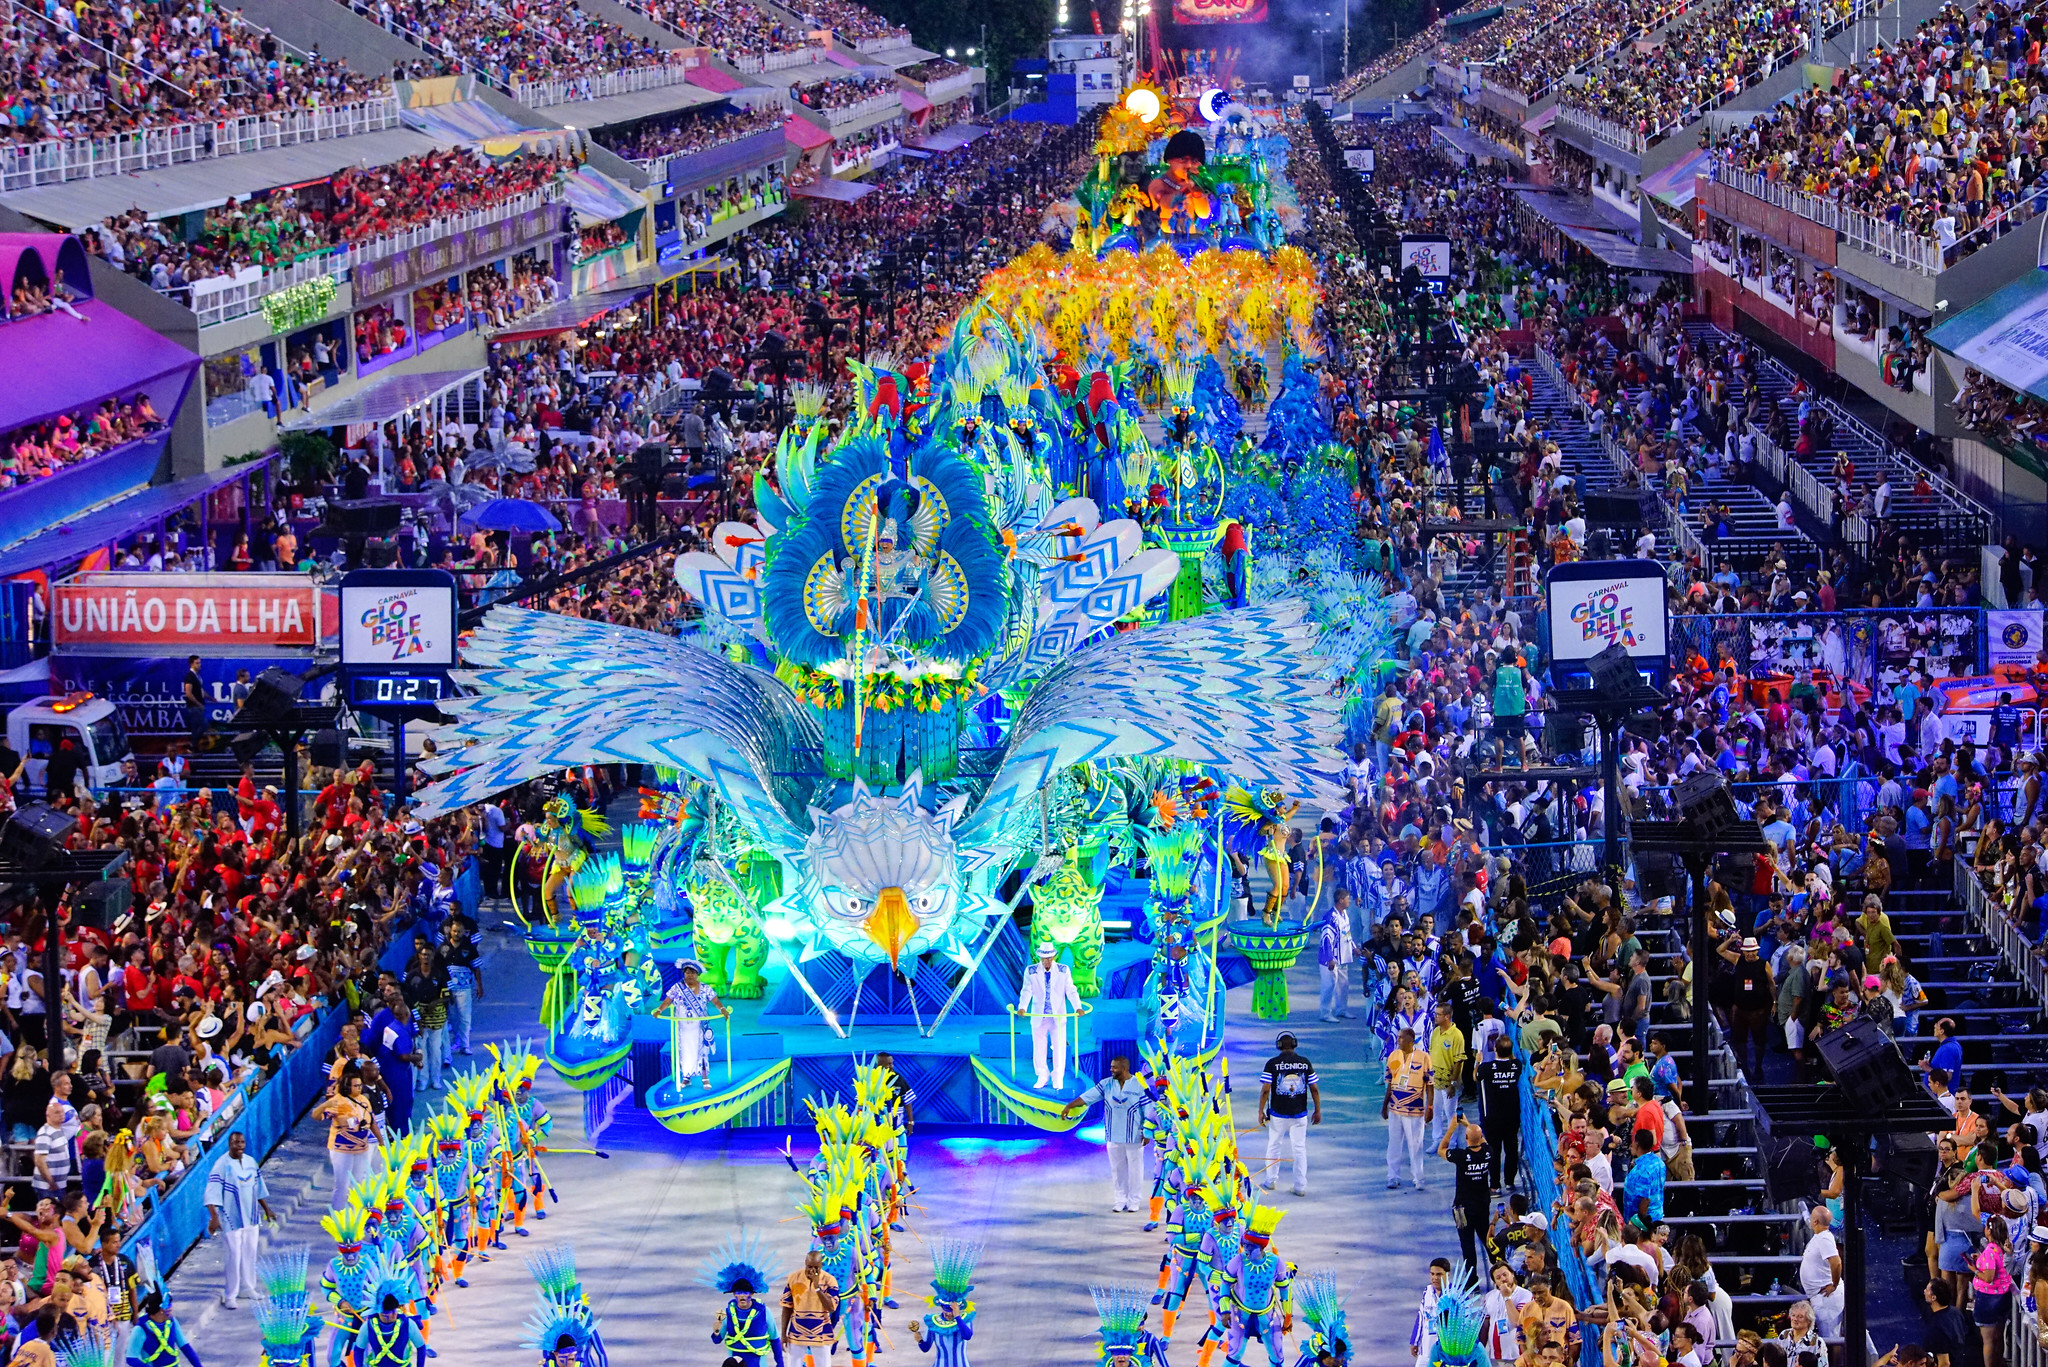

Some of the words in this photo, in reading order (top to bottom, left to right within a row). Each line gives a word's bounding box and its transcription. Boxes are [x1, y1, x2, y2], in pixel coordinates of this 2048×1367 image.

[378, 588, 418, 605] CARNAVAL
[1587, 580, 1629, 599] CARNAVAL
[62, 589, 167, 633] UNIÃO
[176, 597, 221, 633] DA
[230, 597, 304, 633] ILHA
[361, 600, 408, 628] GLO
[1570, 593, 1619, 624] GLO
[371, 613, 421, 646] BELE
[1582, 606, 1634, 642] BELE
[392, 635, 424, 661] ZA
[1603, 628, 1637, 648] ZA
[376, 679, 442, 701] 0:27
[120, 709, 187, 728] AMBA
[1274, 1060, 1309, 1071] TÉCNICA
[1493, 1071, 1515, 1079] STAFF
[1467, 1162, 1489, 1171] STAFF
